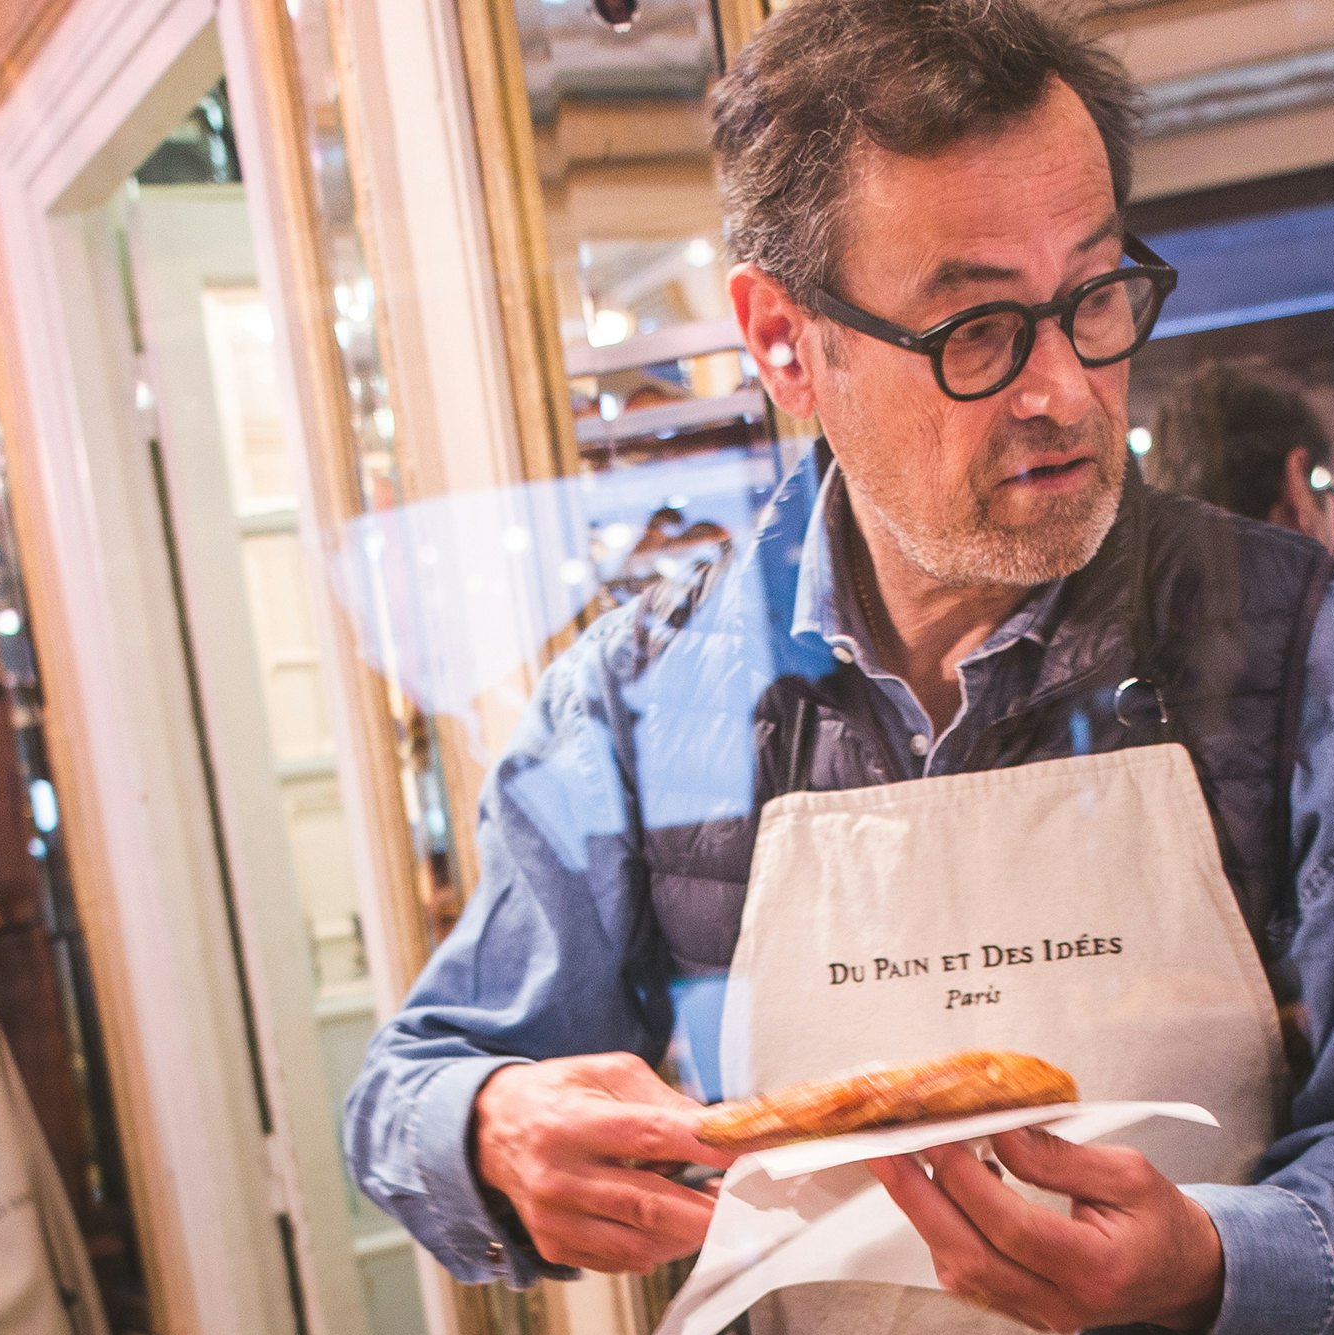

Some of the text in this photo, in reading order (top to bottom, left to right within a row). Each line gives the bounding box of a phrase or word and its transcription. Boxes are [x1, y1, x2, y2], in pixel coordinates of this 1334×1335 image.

[873, 957, 929, 980] PAIN
[942, 953, 970, 972] ET
[981, 944, 1033, 968] DES
[1043, 934, 1123, 961] IDÉES
[945, 985, 1002, 1009] Paris
